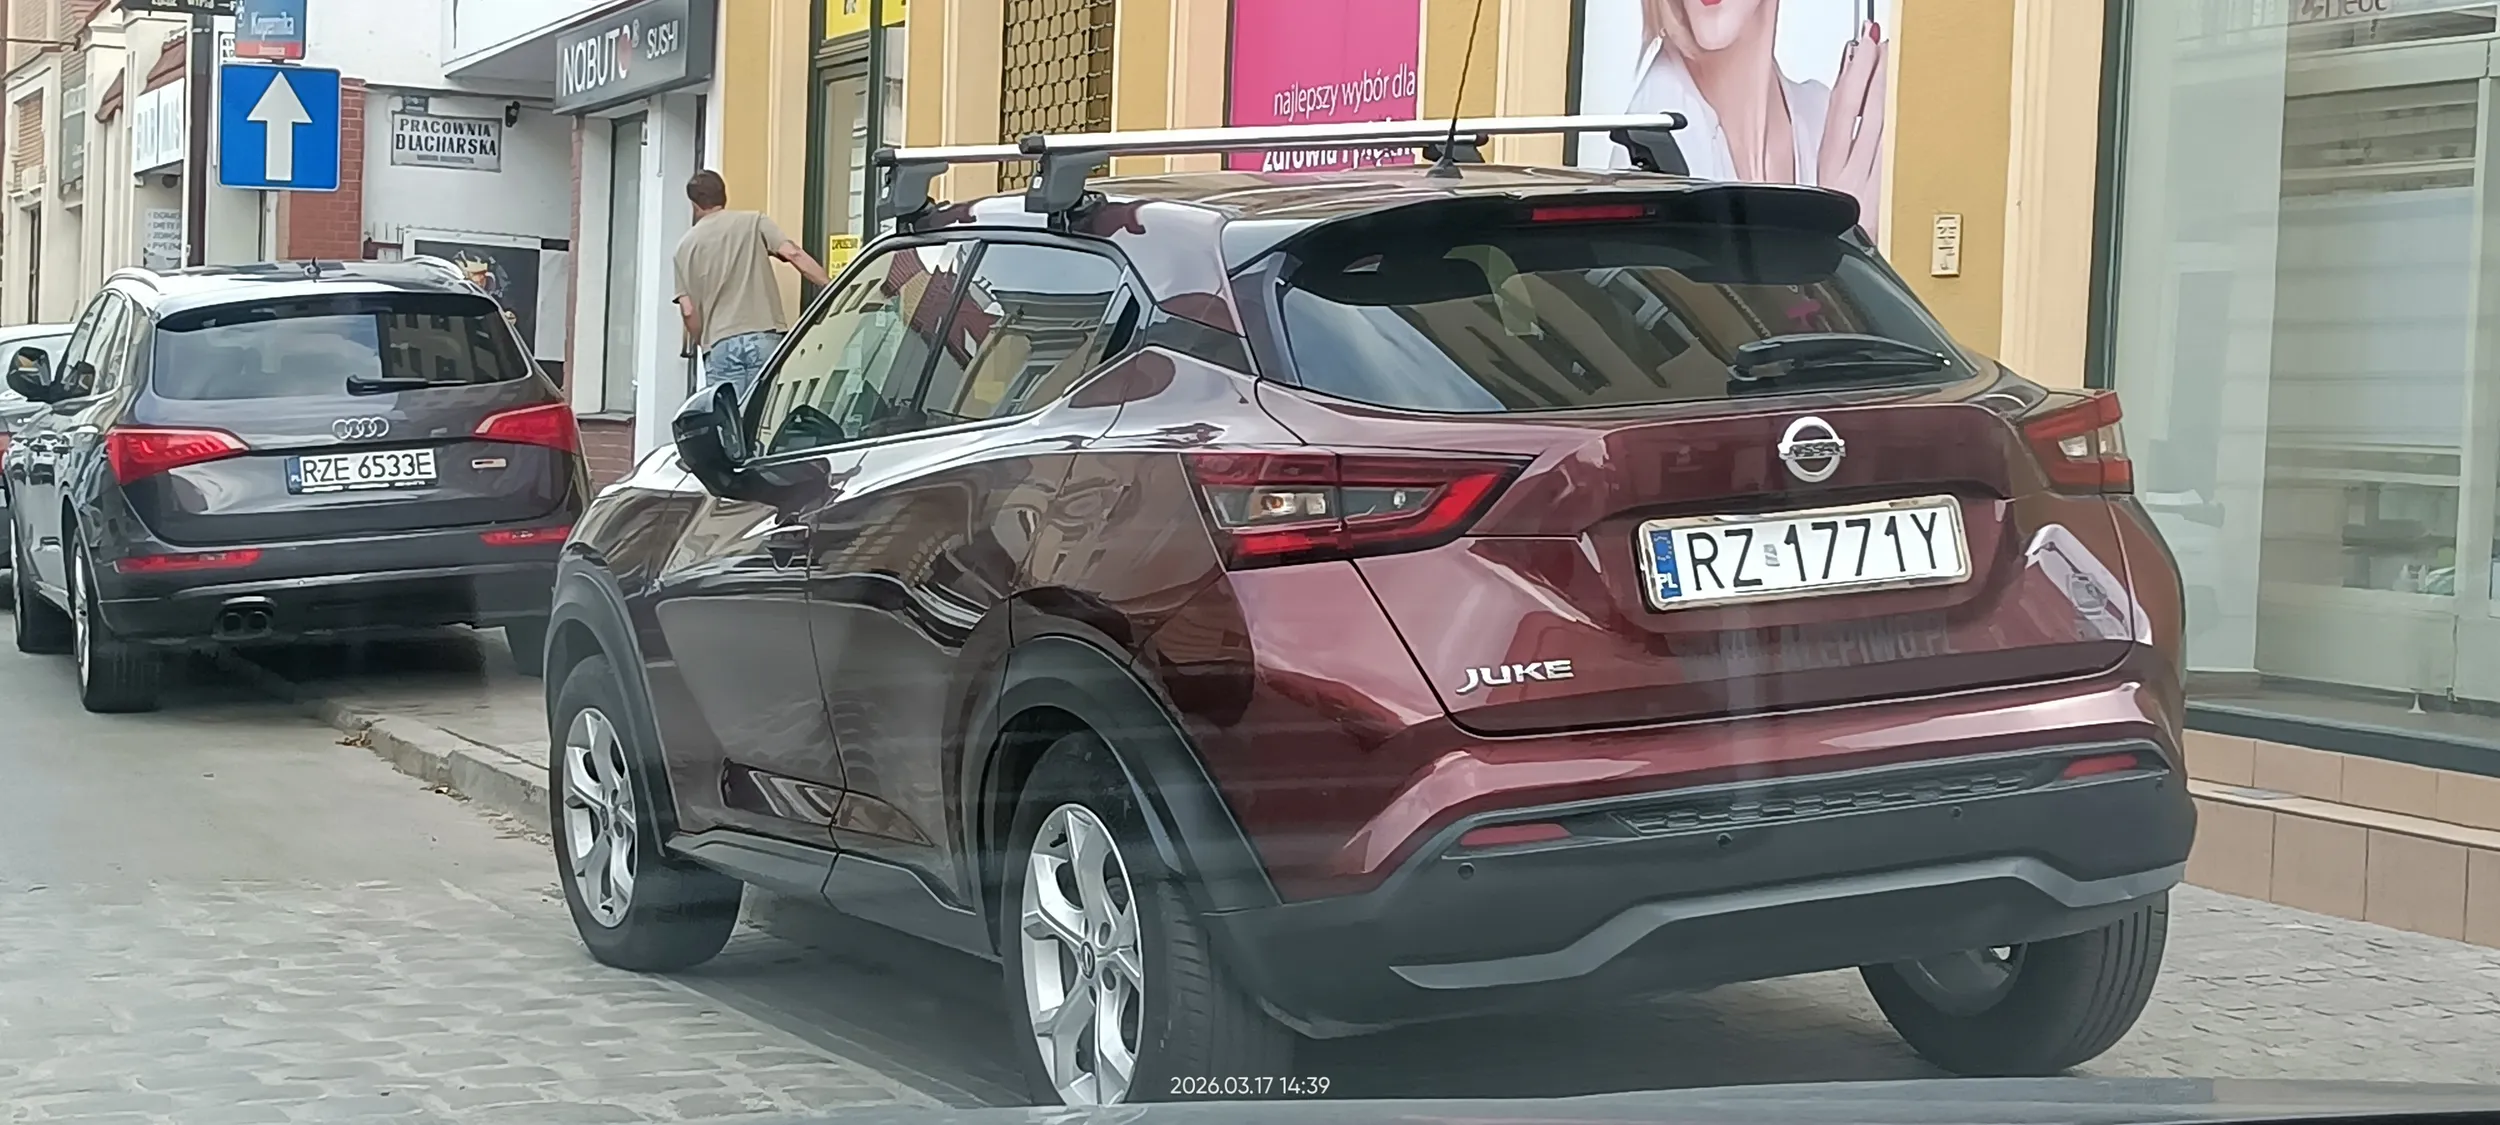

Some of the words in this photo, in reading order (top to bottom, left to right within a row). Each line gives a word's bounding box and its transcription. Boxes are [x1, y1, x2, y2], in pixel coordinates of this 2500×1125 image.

[1273, 81, 1338, 122] najlepszy
[1341, 68, 1389, 113] wybór
[1392, 63, 1415, 98] dla
[399, 118, 491, 137] PRACOWNIA
[395, 133, 497, 156] BLACHARSKA
[303, 457, 351, 483] RZE
[357, 452, 432, 479] 6533E
[1686, 528, 1763, 592] RZ
[1783, 512, 1938, 582] 1771Y
[1656, 573, 1679, 590] PL
[1455, 659, 1575, 695] JUKE
